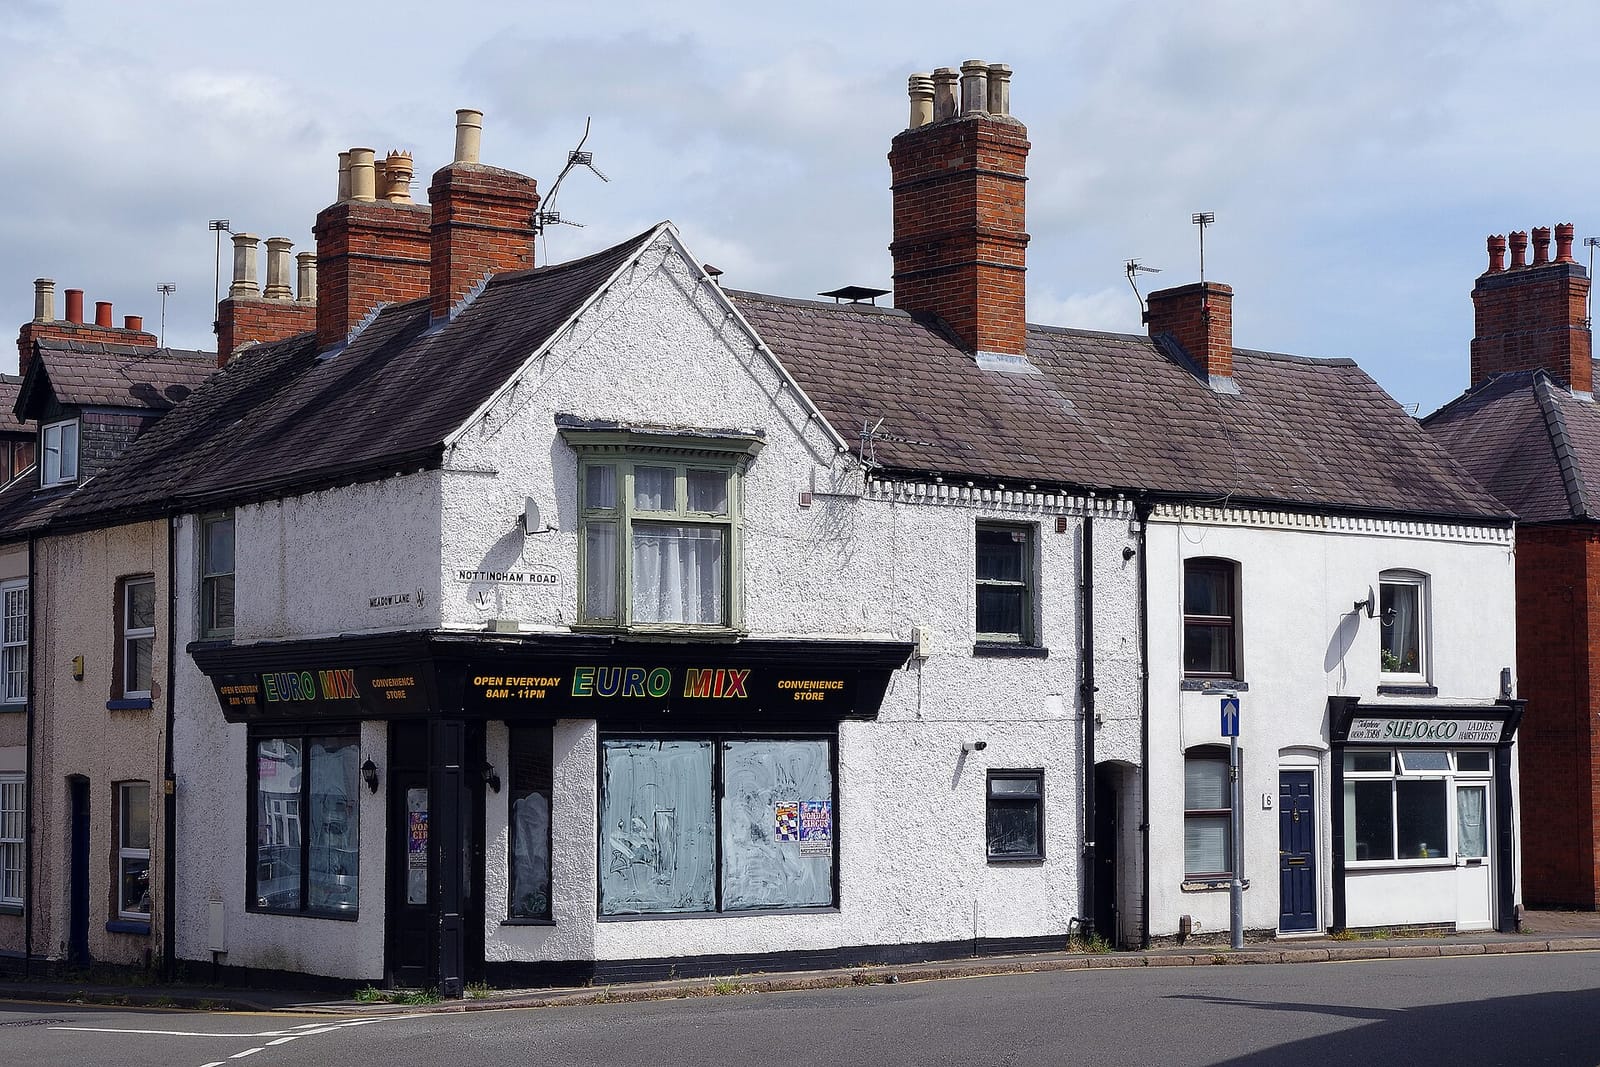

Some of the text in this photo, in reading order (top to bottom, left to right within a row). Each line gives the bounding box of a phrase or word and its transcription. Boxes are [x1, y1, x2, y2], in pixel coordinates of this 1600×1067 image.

[459, 571, 557, 583] NOTTINGHAM ROAD
[369, 594, 410, 607] MEADOW LANE
[263, 669, 361, 702] EURO MIX
[372, 676, 415, 688] CONVENIENCE
[473, 676, 561, 687] OPEN EVERYDAY
[572, 666, 751, 698] EURO MIX
[777, 680, 845, 690] CONVENIENCE
[220, 684, 259, 695] OPEN EVERYDAY
[386, 689, 407, 700] STORE
[485, 689, 509, 699] 8AM
[517, 689, 546, 699] 11PM
[793, 692, 825, 701] STORE
[1467, 721, 1494, 731] LADIES
[1458, 731, 1498, 740] HAIRSTYLISTS
[1266, 795, 1272, 806] 6
